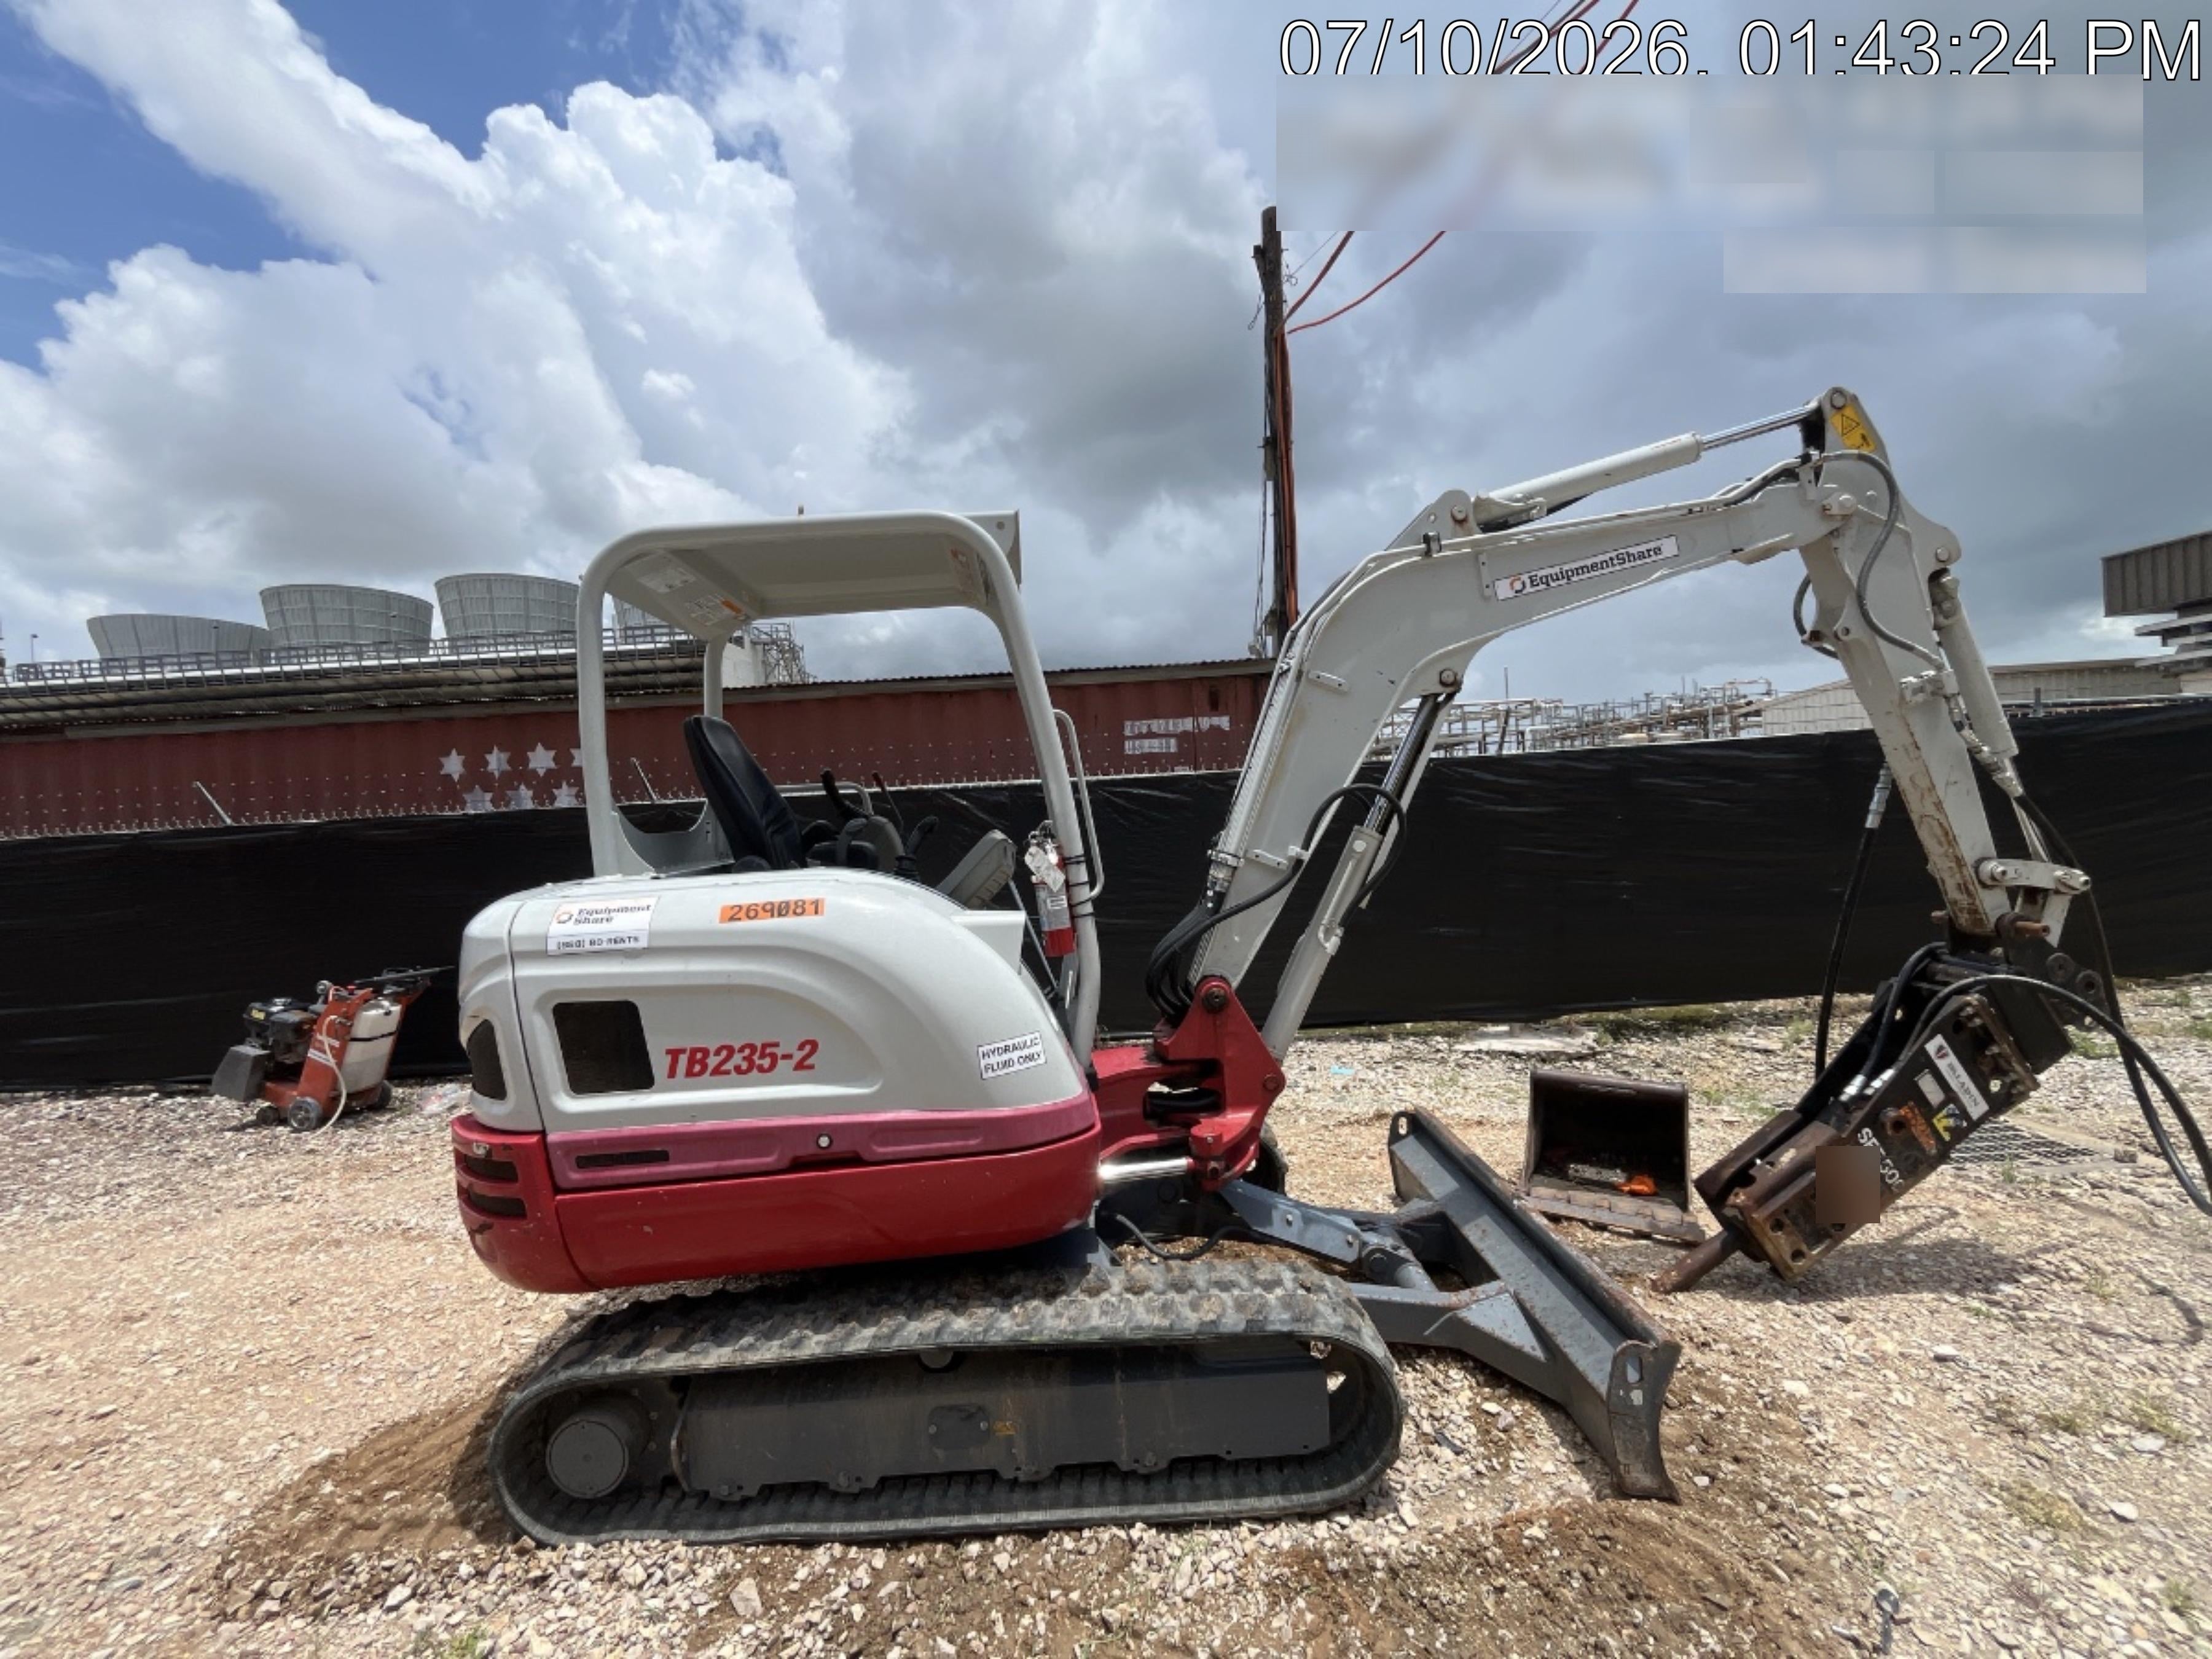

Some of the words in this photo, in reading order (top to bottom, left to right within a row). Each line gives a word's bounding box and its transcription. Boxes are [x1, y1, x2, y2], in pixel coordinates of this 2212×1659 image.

[1528, 546, 1663, 587] EquipmentShare
[728, 899, 820, 922] 269081
[665, 1038, 819, 1079] TB235-2
[982, 1037, 1040, 1060] HYDRAULIC
[984, 1057, 1014, 1073] FLUID
[1018, 1050, 1041, 1065] ONLY
